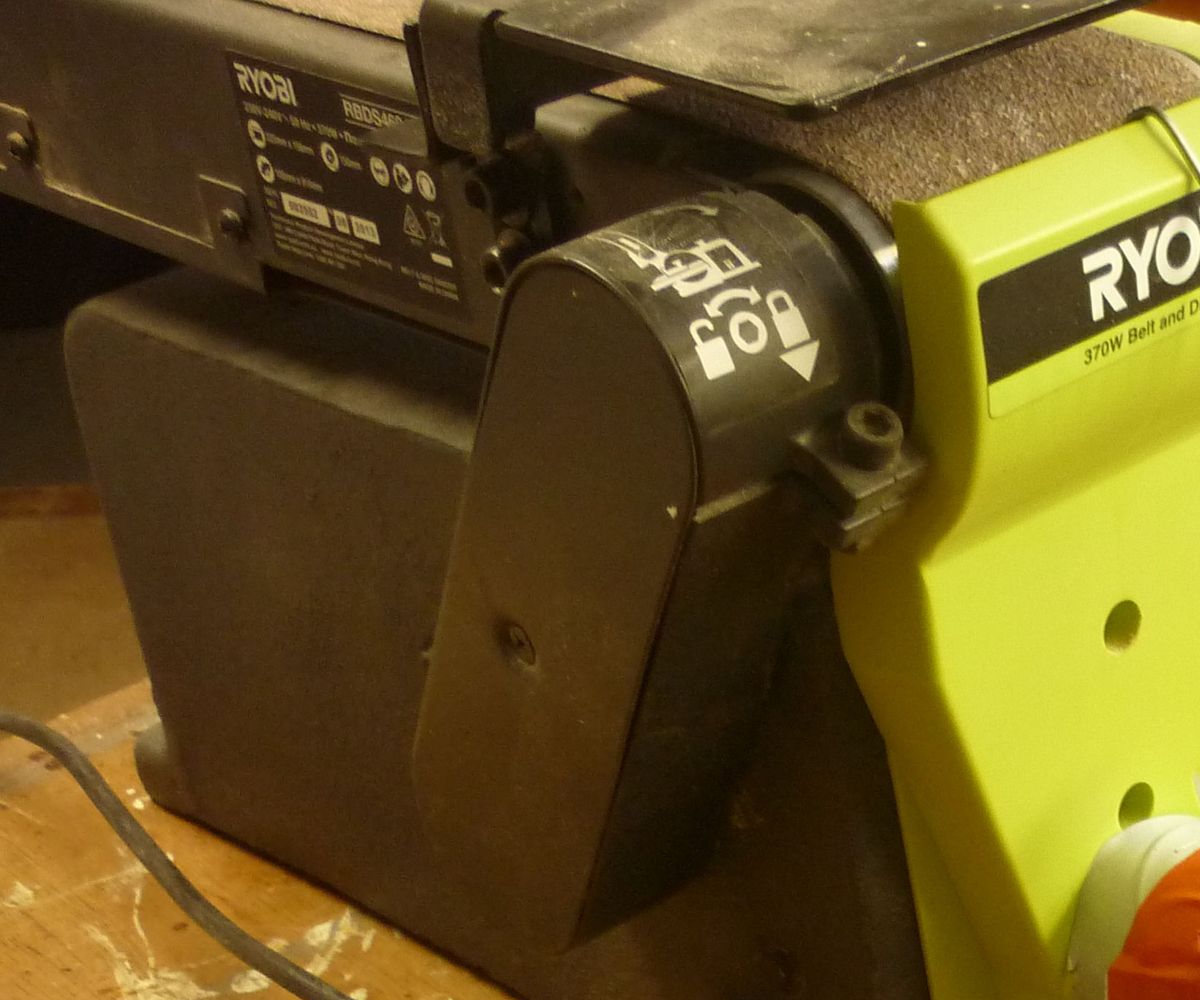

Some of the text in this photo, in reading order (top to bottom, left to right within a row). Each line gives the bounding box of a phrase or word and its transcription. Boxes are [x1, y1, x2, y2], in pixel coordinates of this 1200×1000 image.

[233, 62, 297, 106] RYOBI
[1083, 334, 1123, 366] 370W
[1128, 319, 1156, 344] Belt
[1159, 306, 1186, 330] and
